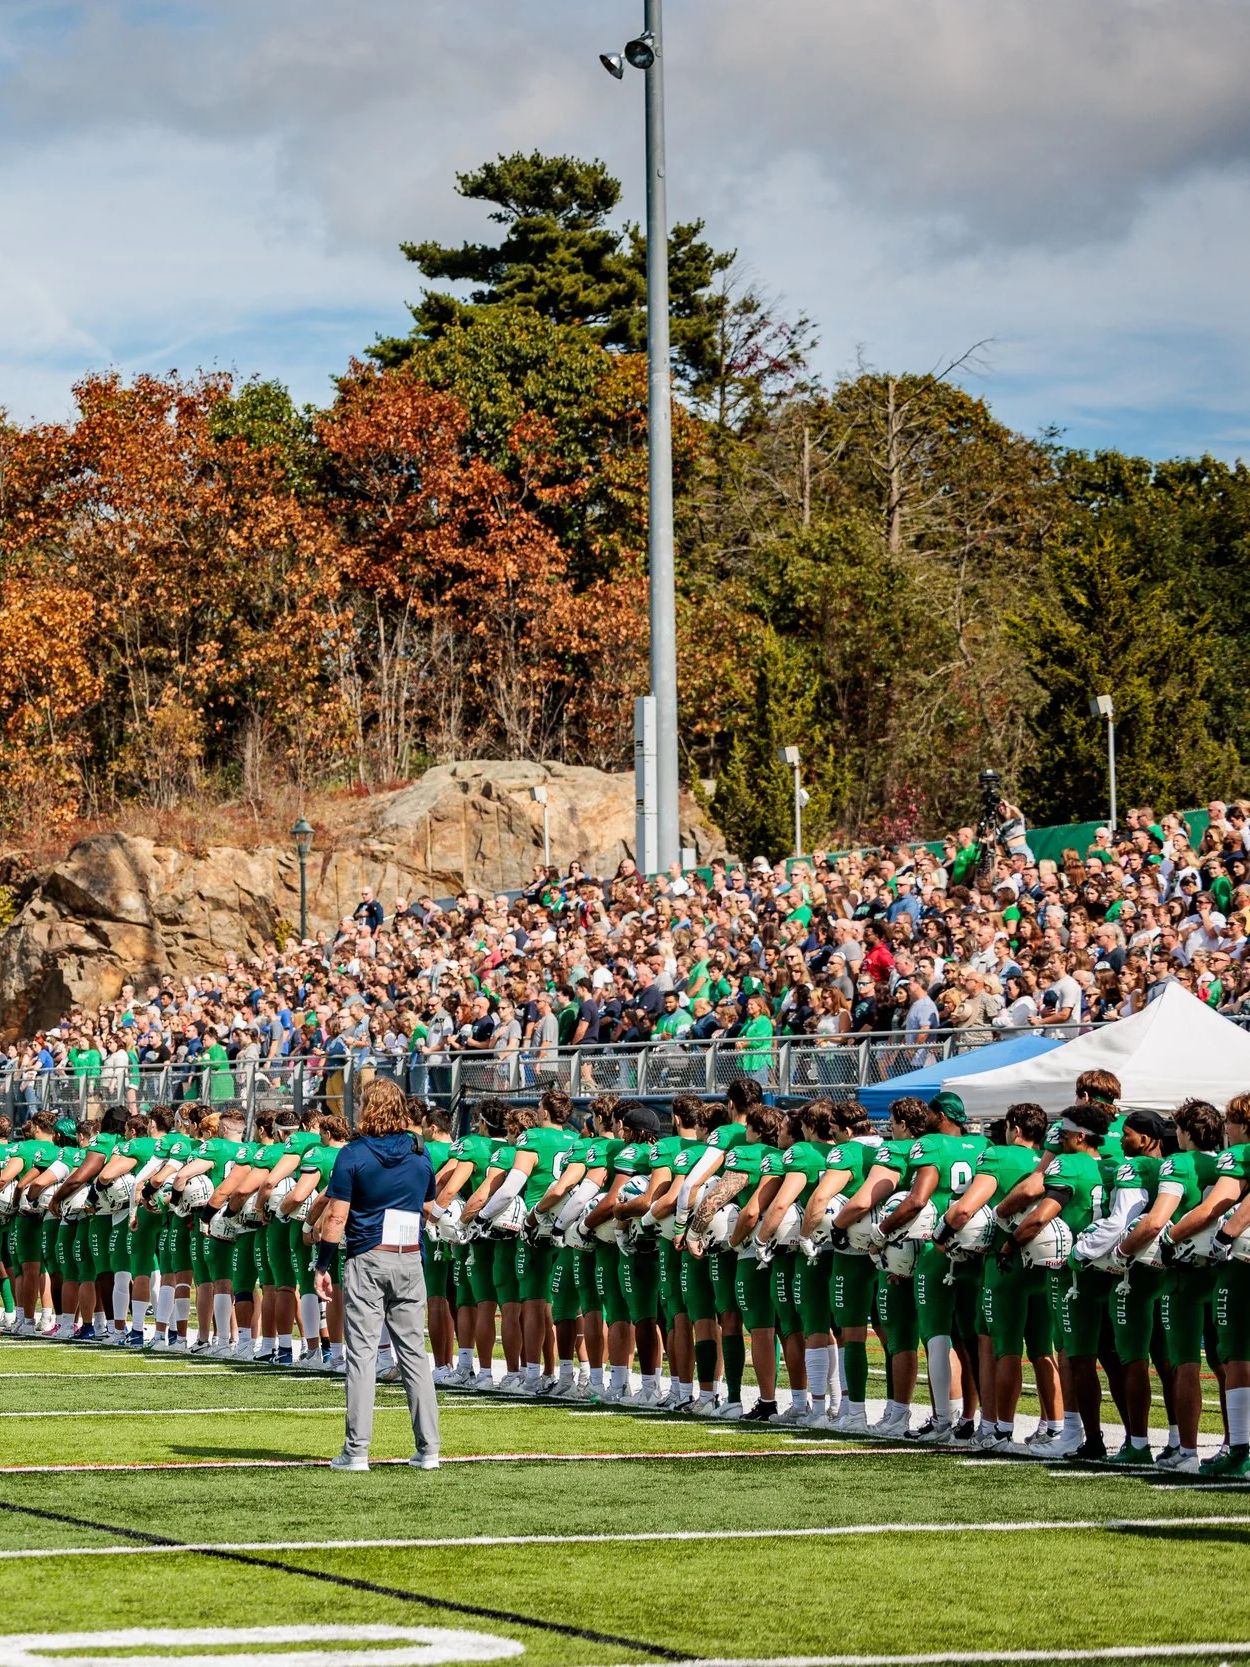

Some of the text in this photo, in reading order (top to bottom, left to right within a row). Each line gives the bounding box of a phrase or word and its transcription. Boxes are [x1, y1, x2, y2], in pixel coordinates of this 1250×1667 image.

[109, 1229, 119, 1252] GULLS
[158, 1229, 168, 1251] GULLS
[170, 1229, 178, 1252] GULLS
[453, 1260, 461, 1287] GULLS
[517, 1247, 525, 1274] GULLS
[551, 1265, 563, 1293] GULLS
[597, 1266, 605, 1295] GULLS
[623, 1264, 632, 1293] GULLS
[777, 1272, 787, 1303] GULLS
[793, 1273, 801, 1305] GULLS
[835, 1275, 844, 1308] GULLS
[918, 1273, 926, 1305] GULLS
[736, 1281, 748, 1311] GULLS
[879, 1287, 888, 1321] GULLS
[985, 1288, 993, 1323] GULLS
[1116, 1288, 1127, 1325] GULLS
[1217, 1288, 1229, 1326] GULLS
[1060, 1296, 1071, 1333] GULLS
[1161, 1294, 1171, 1330] GULLS
